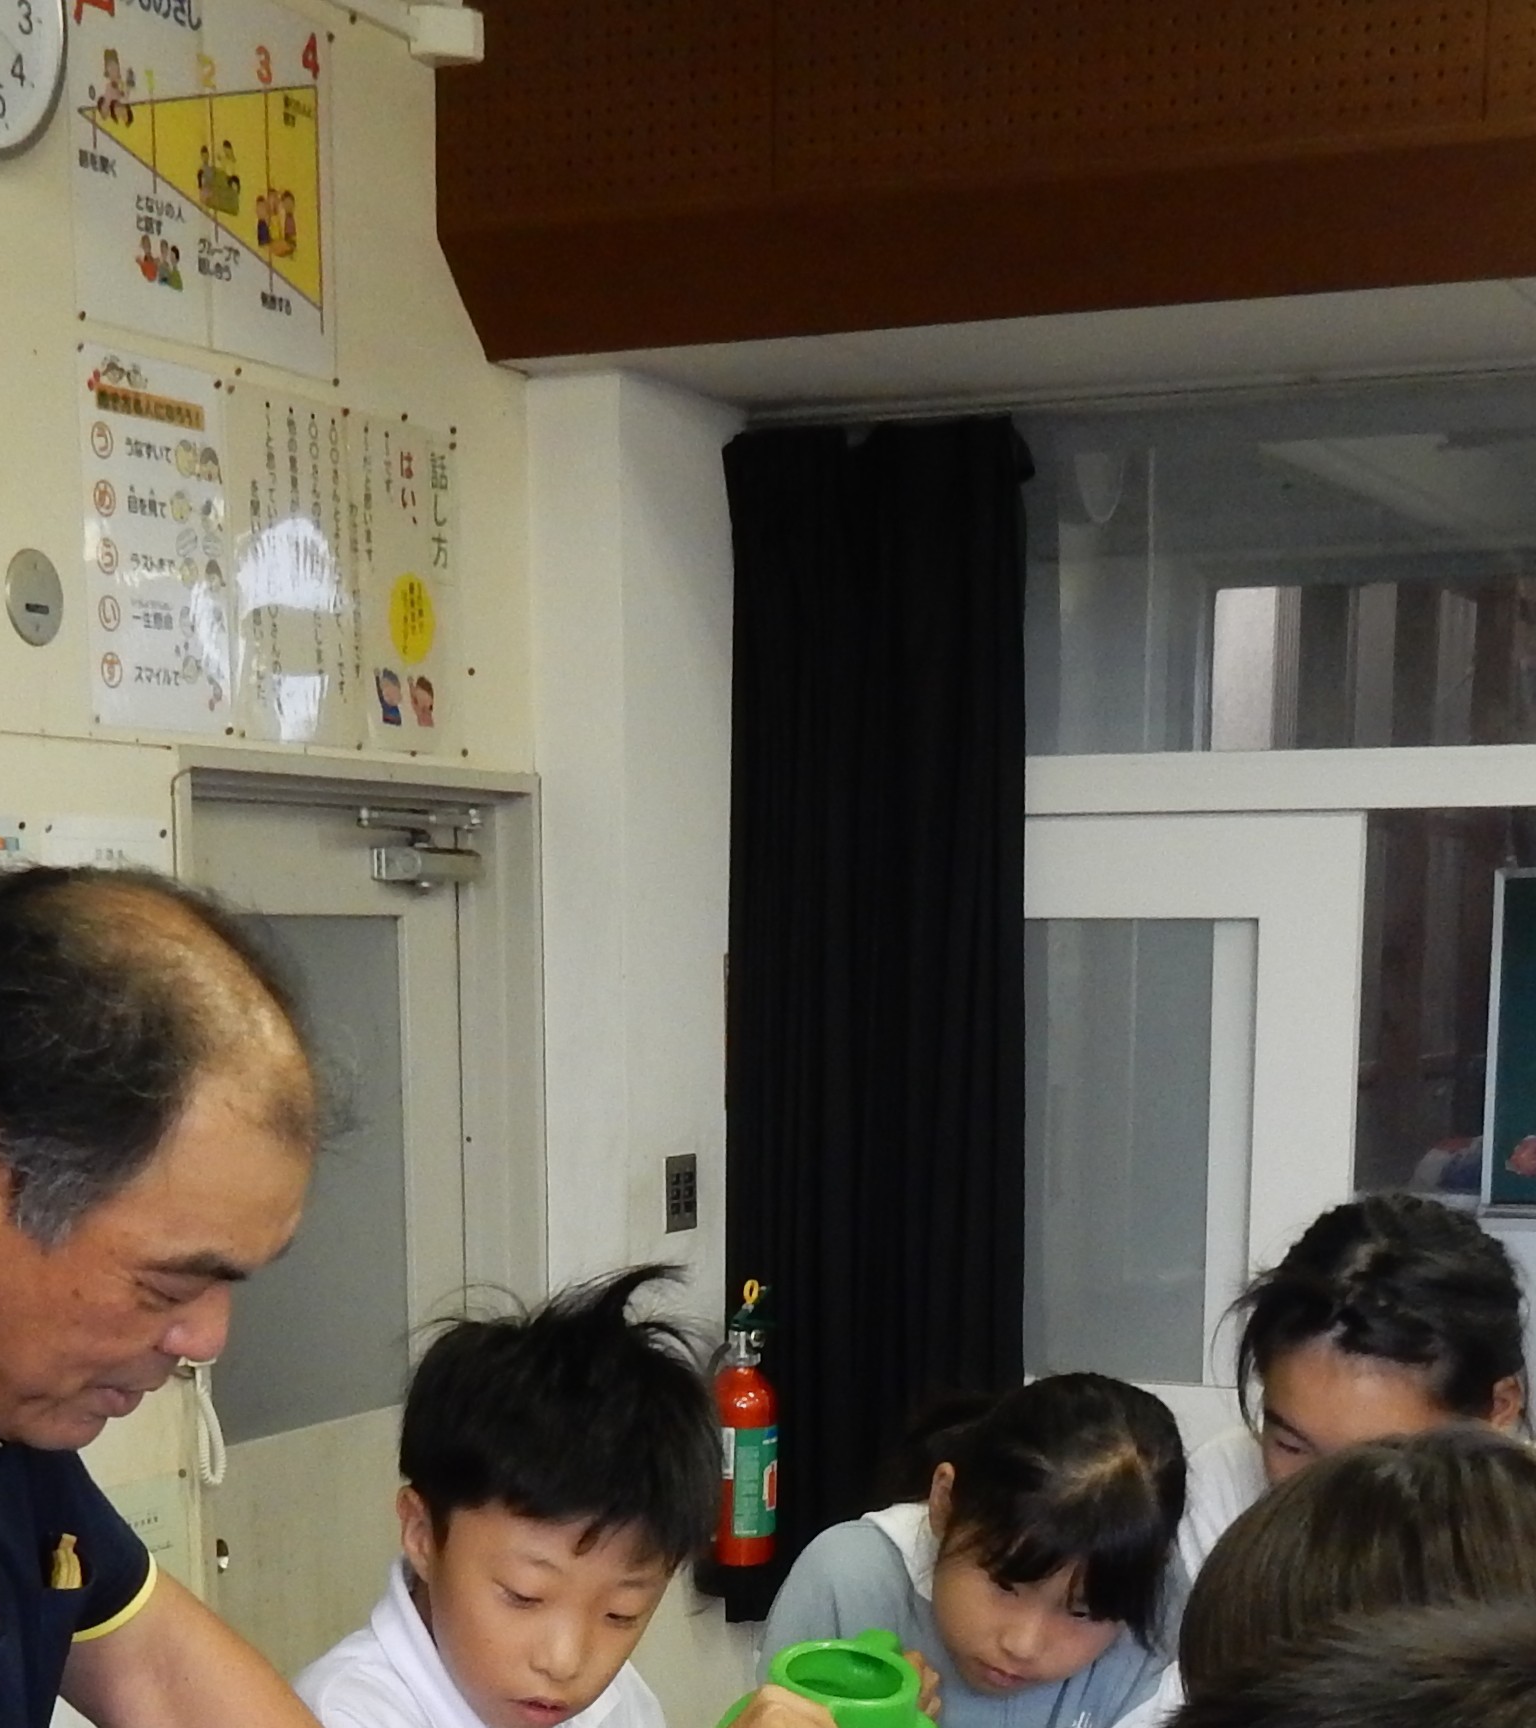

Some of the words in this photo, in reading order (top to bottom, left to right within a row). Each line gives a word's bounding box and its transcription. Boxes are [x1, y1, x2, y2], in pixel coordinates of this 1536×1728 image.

[17, 0, 33, 35] 3
[11, 53, 26, 88] 4
[197, 52, 216, 89] 2
[256, 45, 272, 85] 3
[302, 32, 320, 80] 4
[430, 452, 448, 569] 話し方
